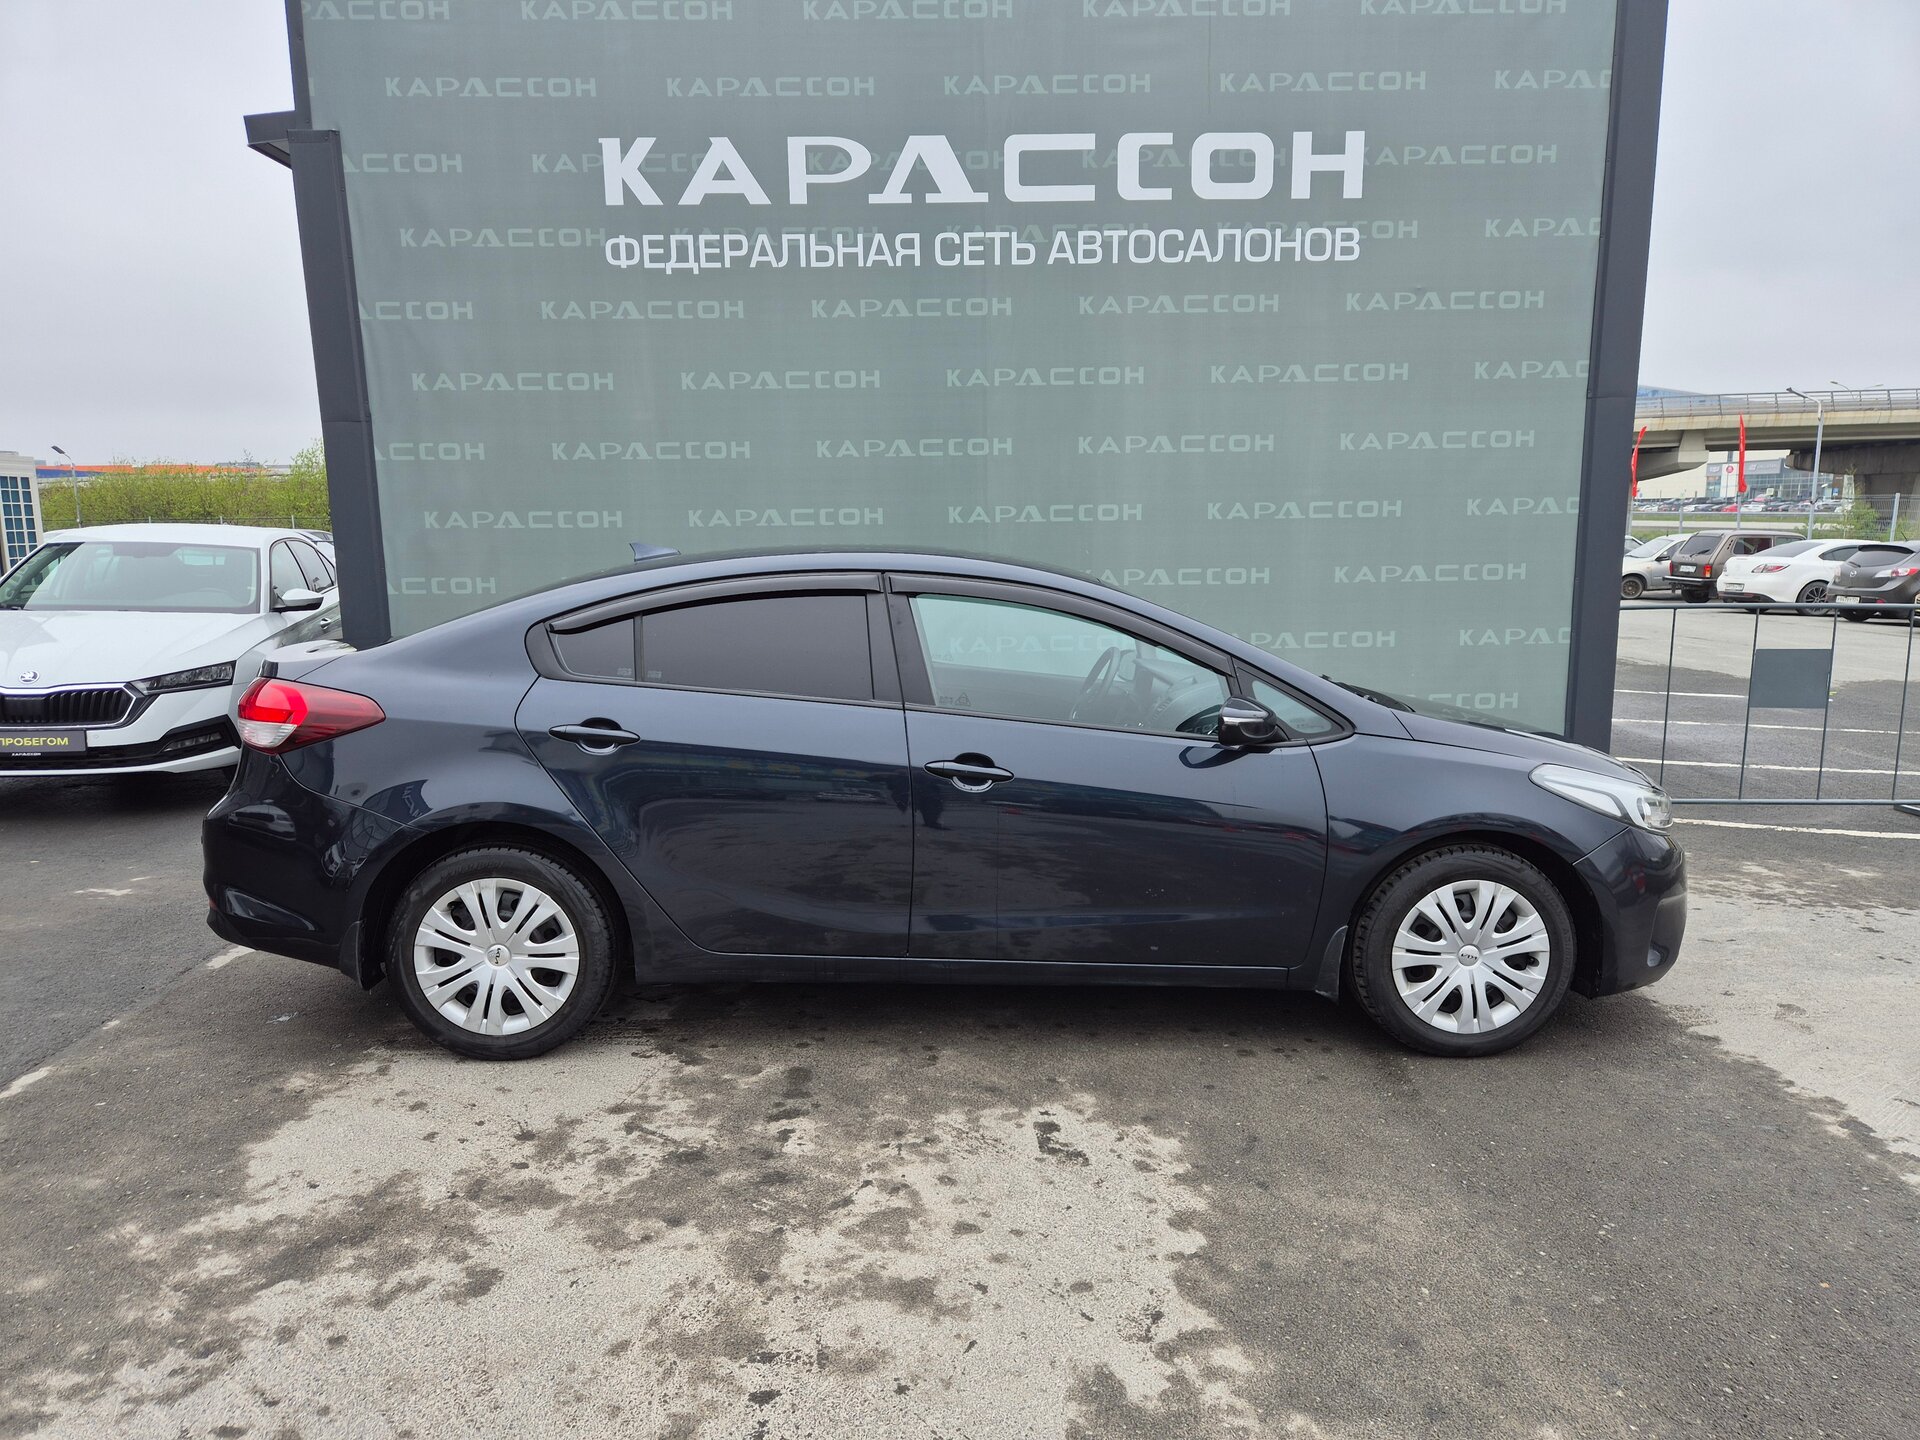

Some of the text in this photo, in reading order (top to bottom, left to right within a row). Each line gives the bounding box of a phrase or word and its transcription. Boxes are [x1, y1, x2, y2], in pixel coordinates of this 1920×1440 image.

[605, 227, 1361, 275] ФЕДЕРАЛЬНАЯ СЕТЬ АВТОСАЛОНОВ
